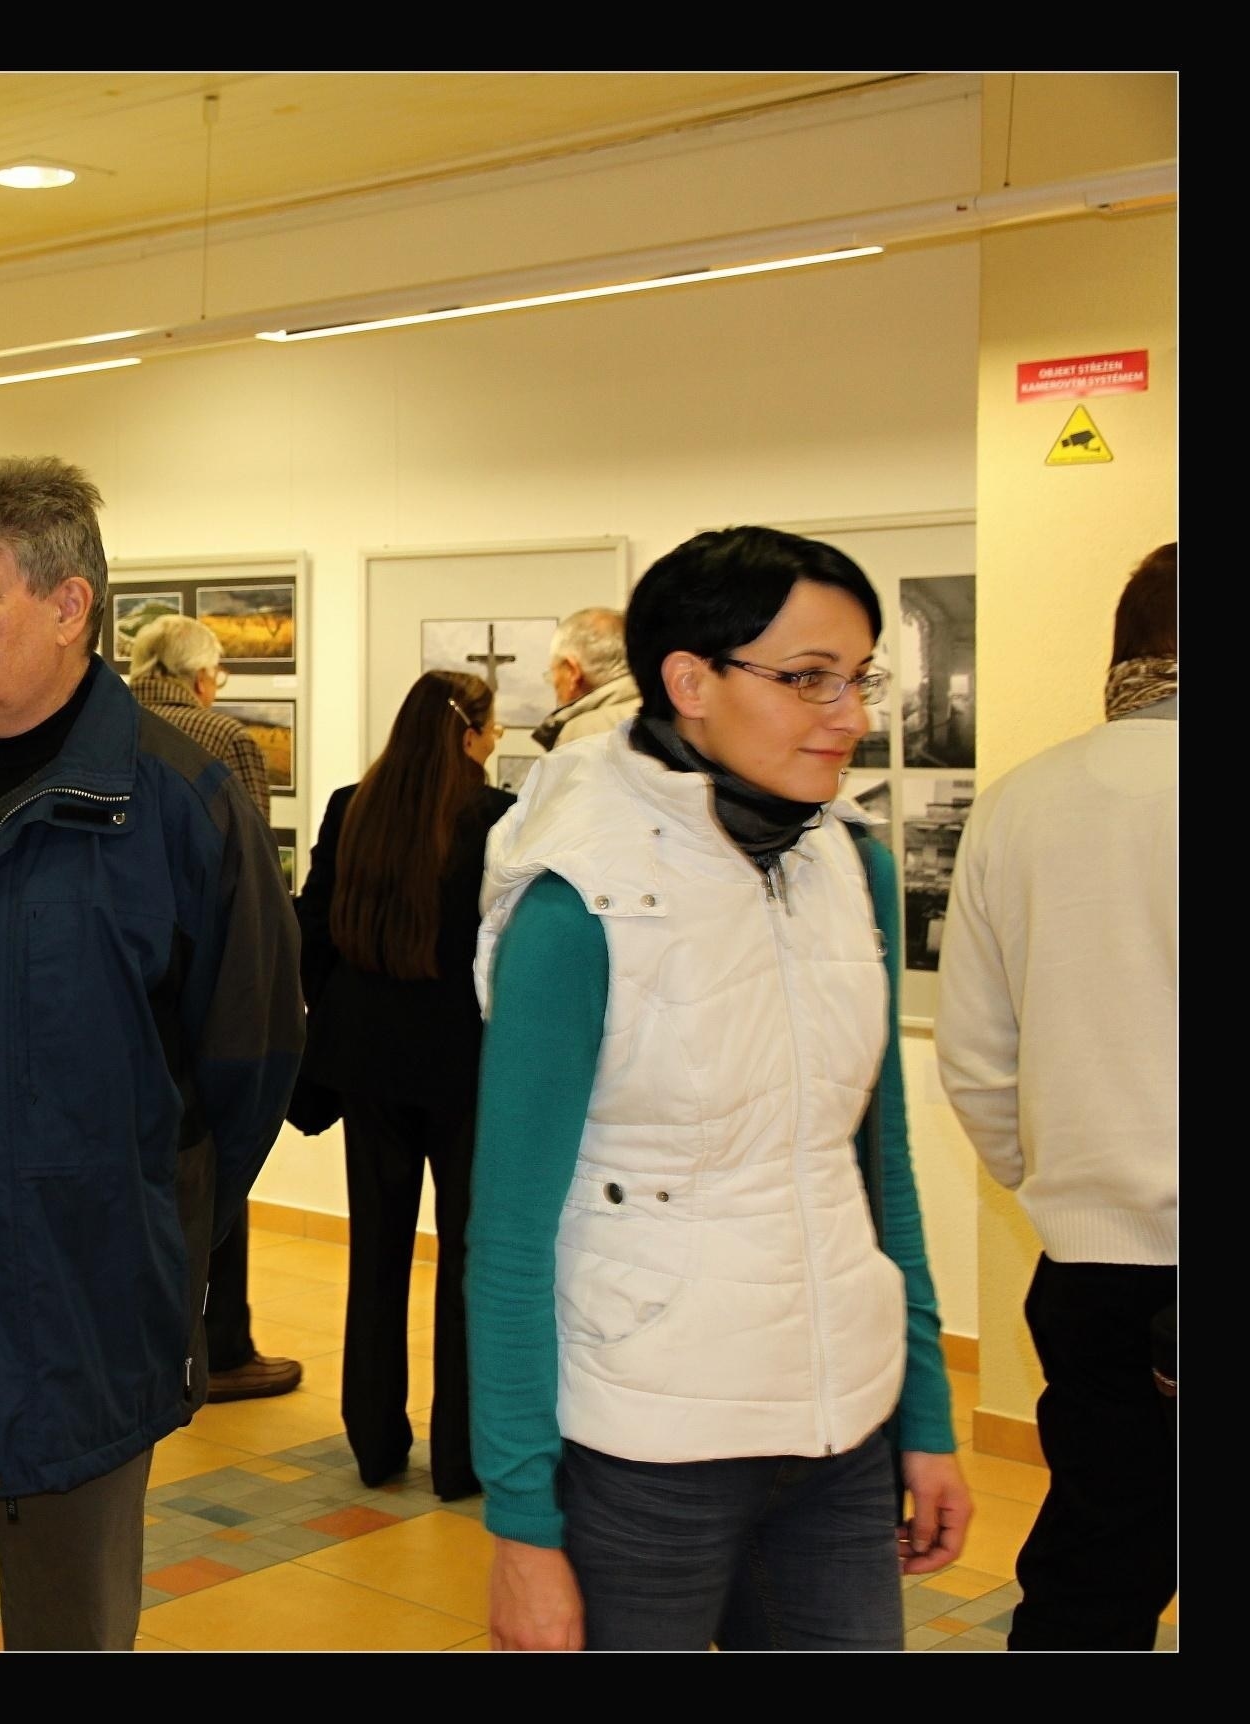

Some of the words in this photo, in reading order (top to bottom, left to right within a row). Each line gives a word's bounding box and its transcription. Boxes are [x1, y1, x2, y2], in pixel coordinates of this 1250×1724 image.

[1038, 364, 1075, 379] OBJEKT
[1078, 359, 1123, 375] STŘEŽEN
[1020, 376, 1087, 393] KAMEROVÝM
[1087, 370, 1144, 387] SYSTÉMEM
